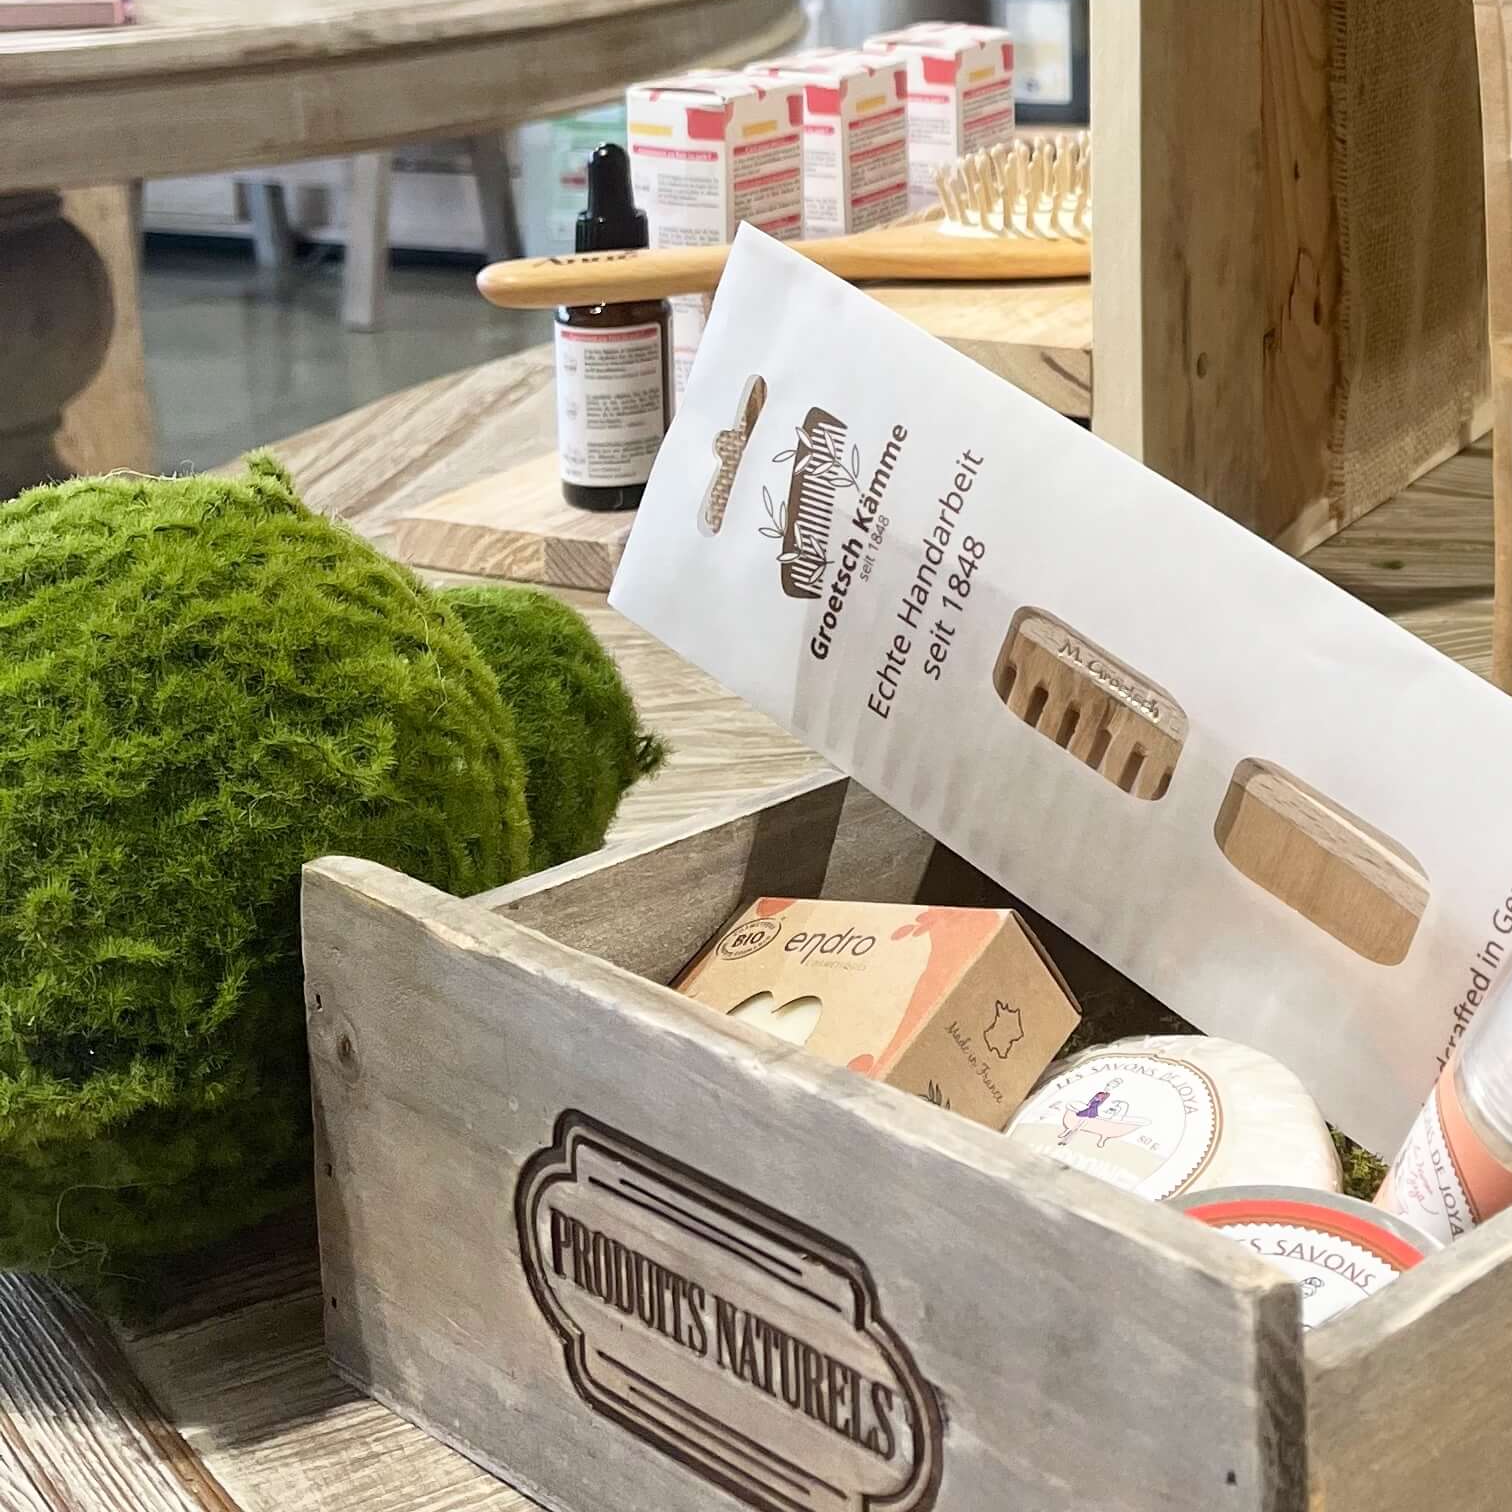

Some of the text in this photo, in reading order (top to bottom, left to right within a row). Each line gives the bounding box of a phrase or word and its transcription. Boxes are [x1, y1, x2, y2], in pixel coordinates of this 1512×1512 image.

[810, 424, 909, 661] Groetsch Kämme
[858, 514, 891, 583] seit 1848
[868, 447, 985, 719] Echte Handarbeit
[923, 535, 986, 682] seit 1848
[731, 930, 766, 949] BIO
[784, 926, 877, 965] endro
[1476, 938, 1505, 969] in
[1091, 1062, 1155, 1079] SAVONS
[1430, 1149, 1465, 1243] DE JOYA
[1273, 1238, 1377, 1289] SAVONS
[548, 1206, 896, 1462] PRODUITS NATURELS
